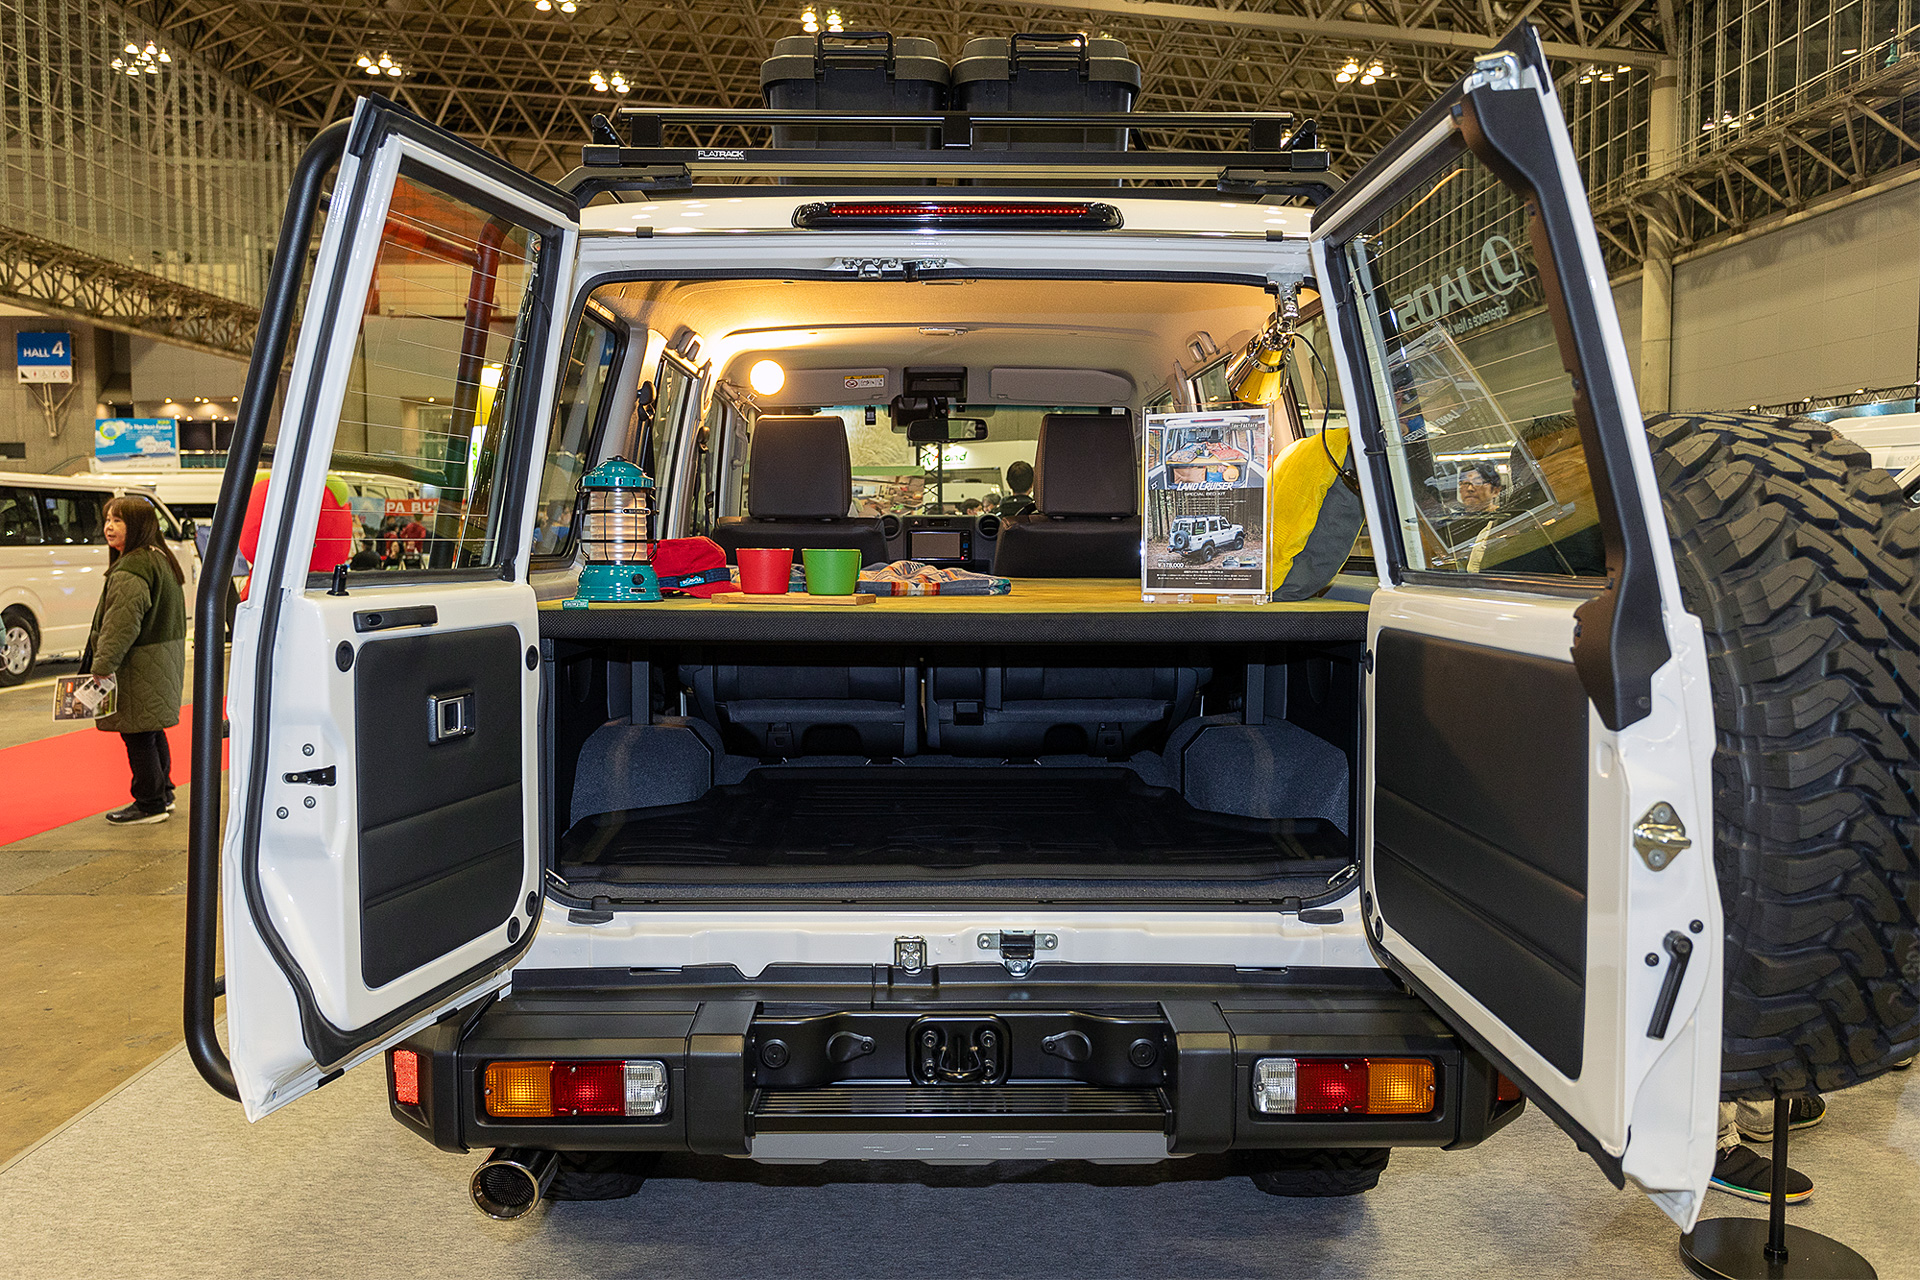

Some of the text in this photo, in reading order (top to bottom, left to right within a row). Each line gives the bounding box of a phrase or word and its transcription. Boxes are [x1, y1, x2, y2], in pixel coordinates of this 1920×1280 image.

[697, 150, 744, 158] FLATRACK
[23, 341, 65, 358] HALL 4
[1176, 480, 1234, 491] LAND CRUISER
